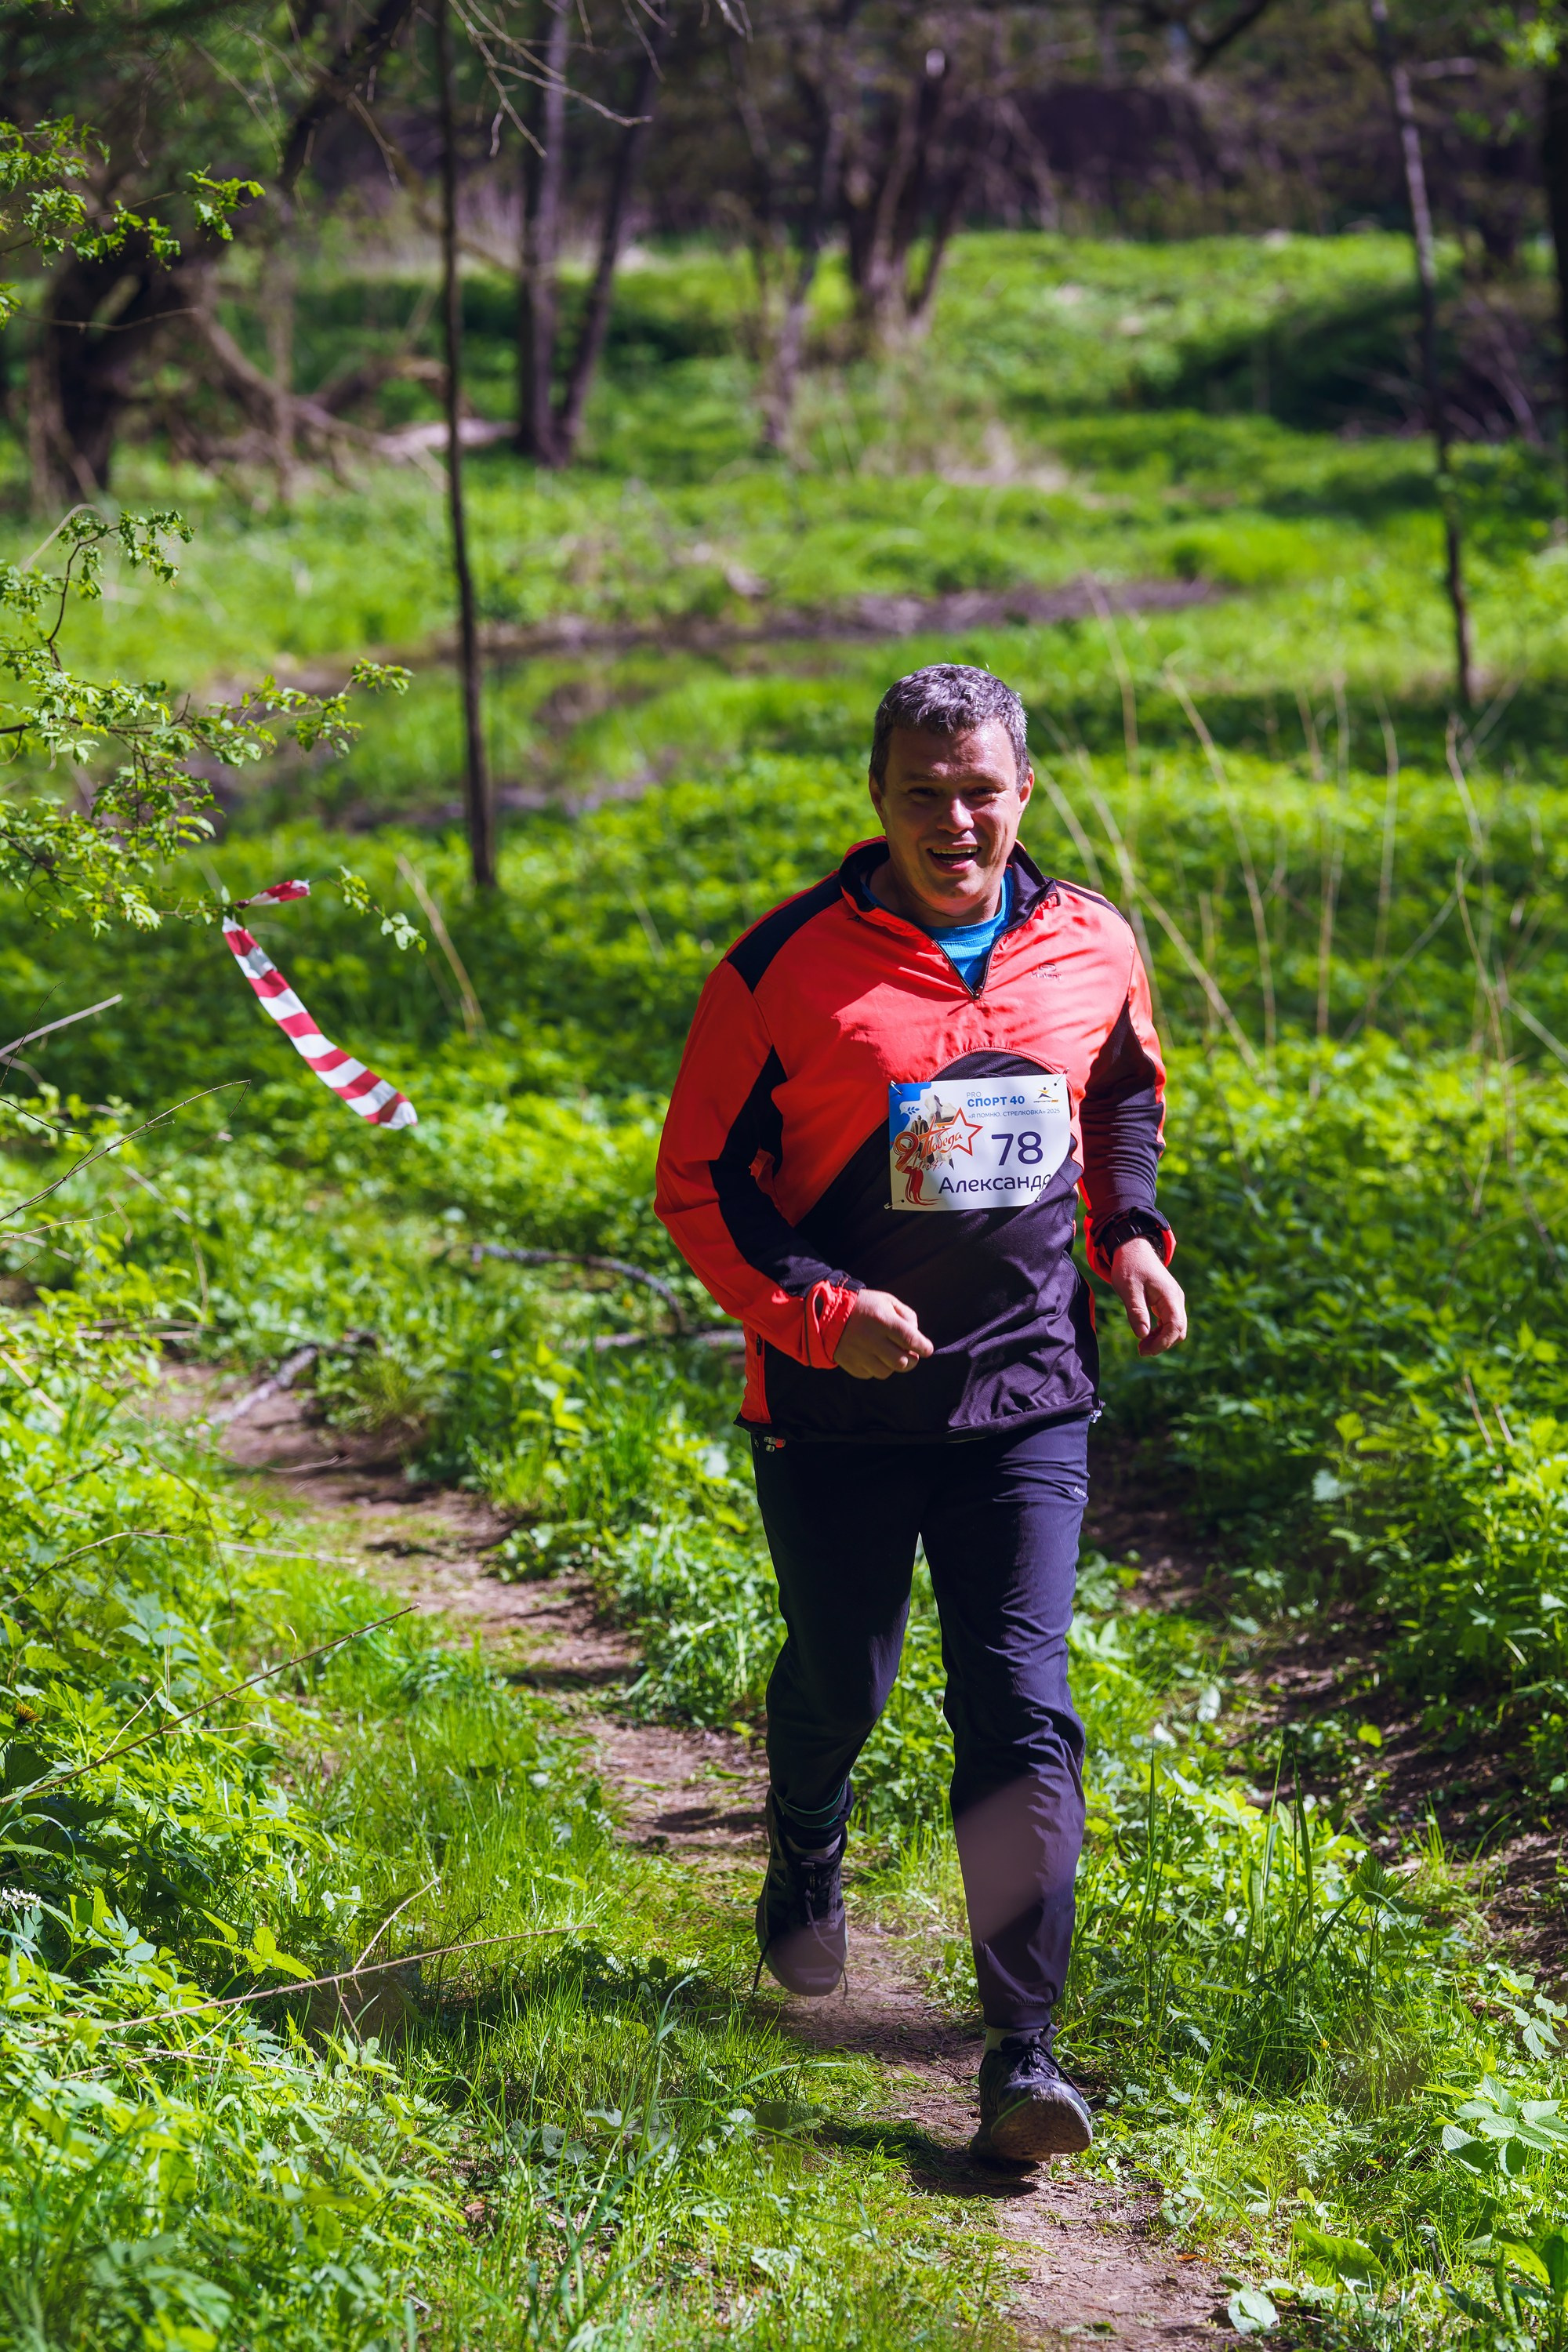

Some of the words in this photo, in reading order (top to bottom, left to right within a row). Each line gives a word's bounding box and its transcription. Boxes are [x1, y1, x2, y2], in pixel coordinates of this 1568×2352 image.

[967, 1097, 1007, 1107] СПОРТ
[1010, 1095, 1025, 1105] 40
[991, 1131, 1044, 1167] 78
